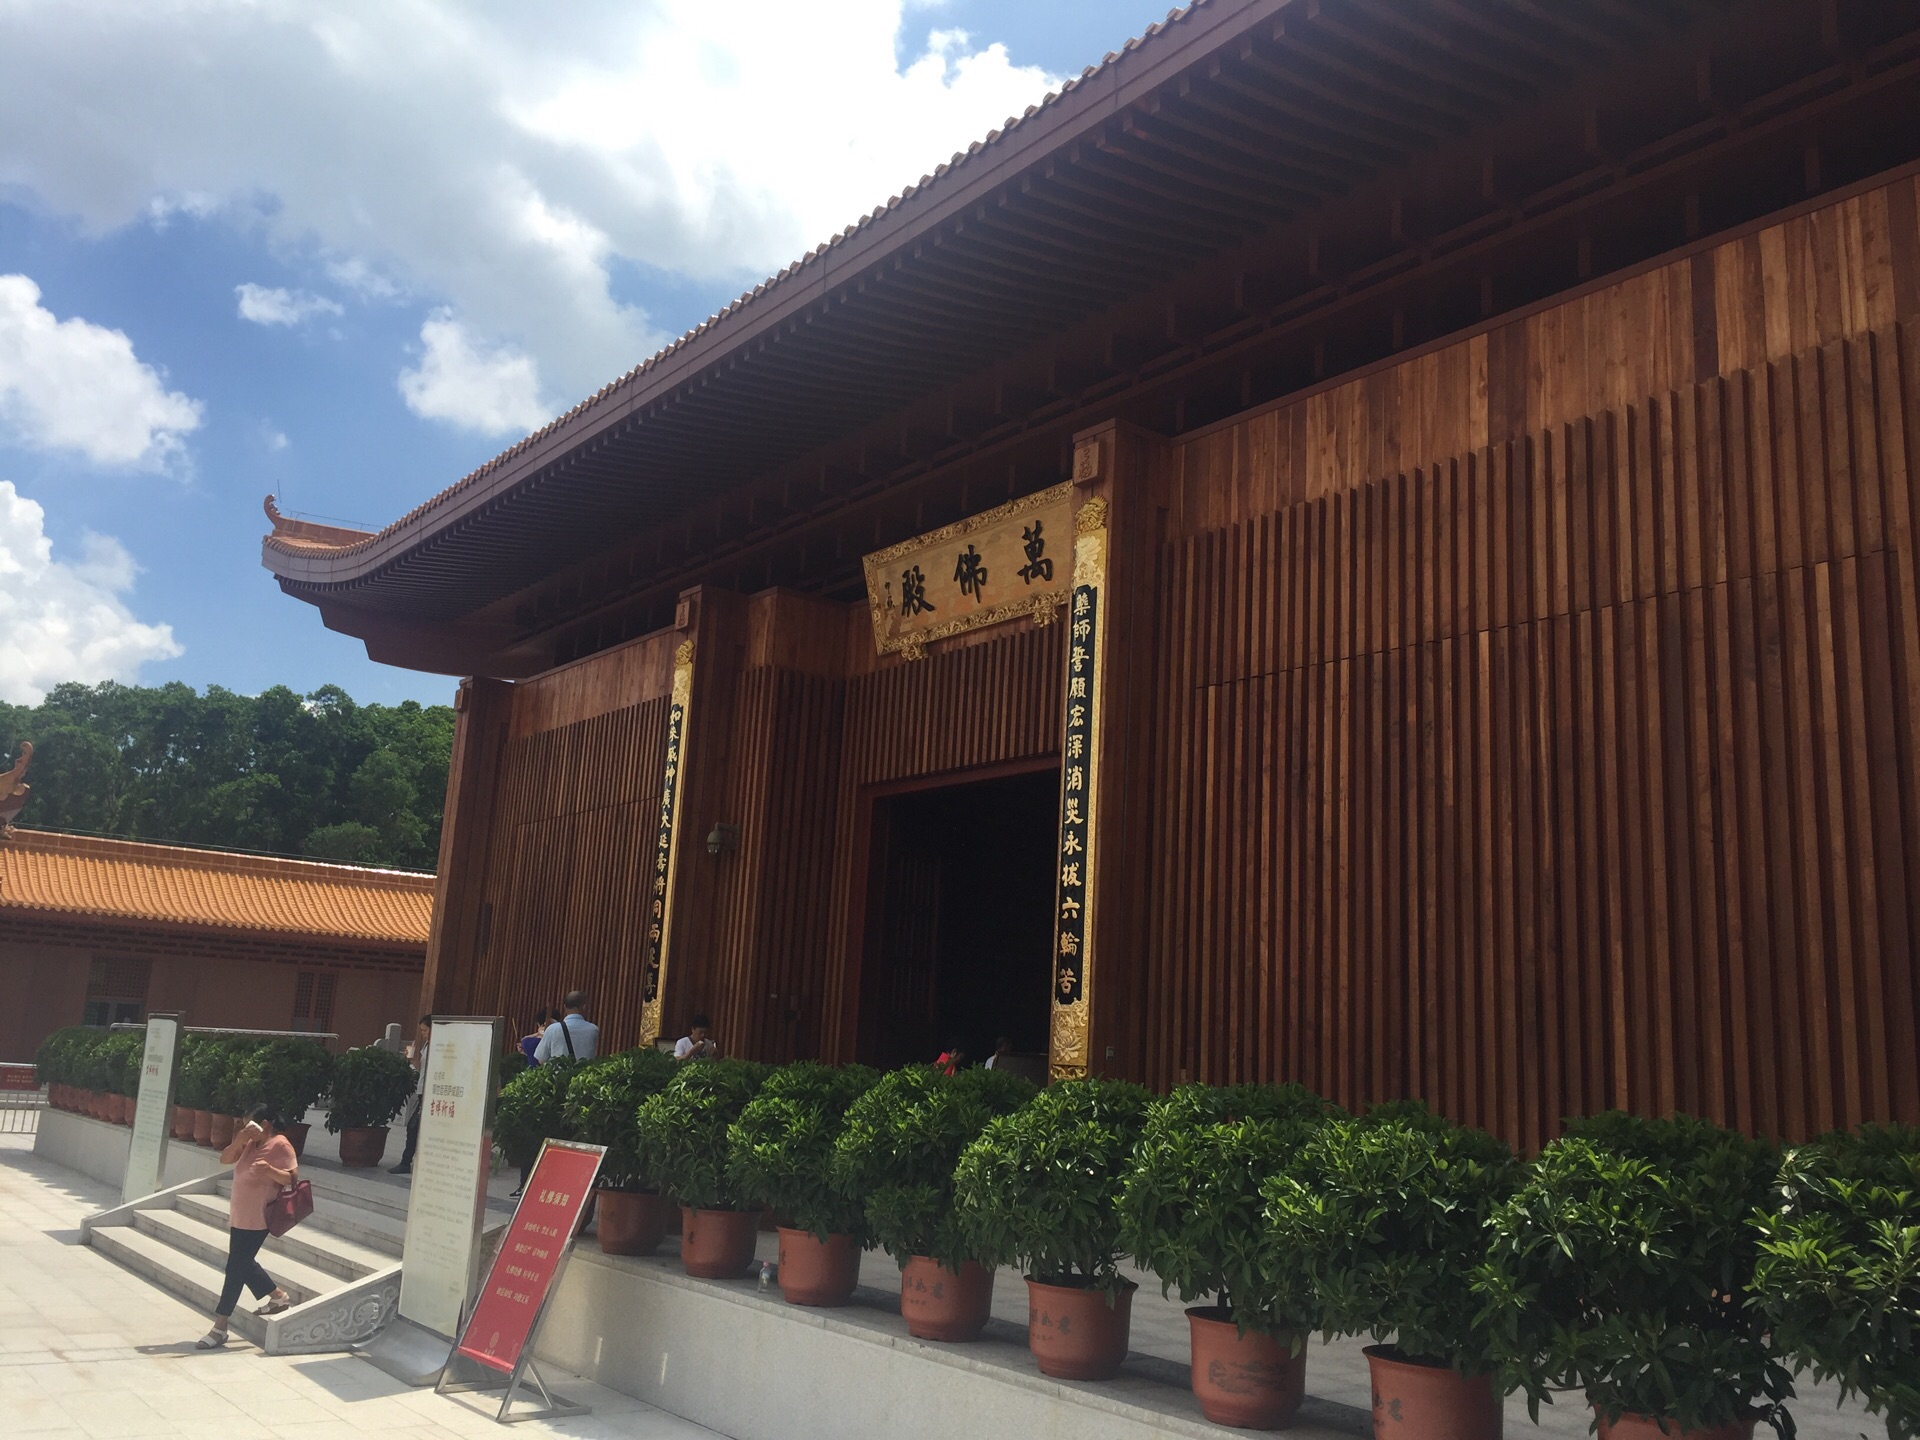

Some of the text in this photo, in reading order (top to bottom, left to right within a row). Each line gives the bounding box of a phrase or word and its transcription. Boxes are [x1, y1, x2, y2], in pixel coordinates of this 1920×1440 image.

[901, 519, 1054, 618] 萬佛殿
[538, 1189, 570, 1207] 礼佛须知
